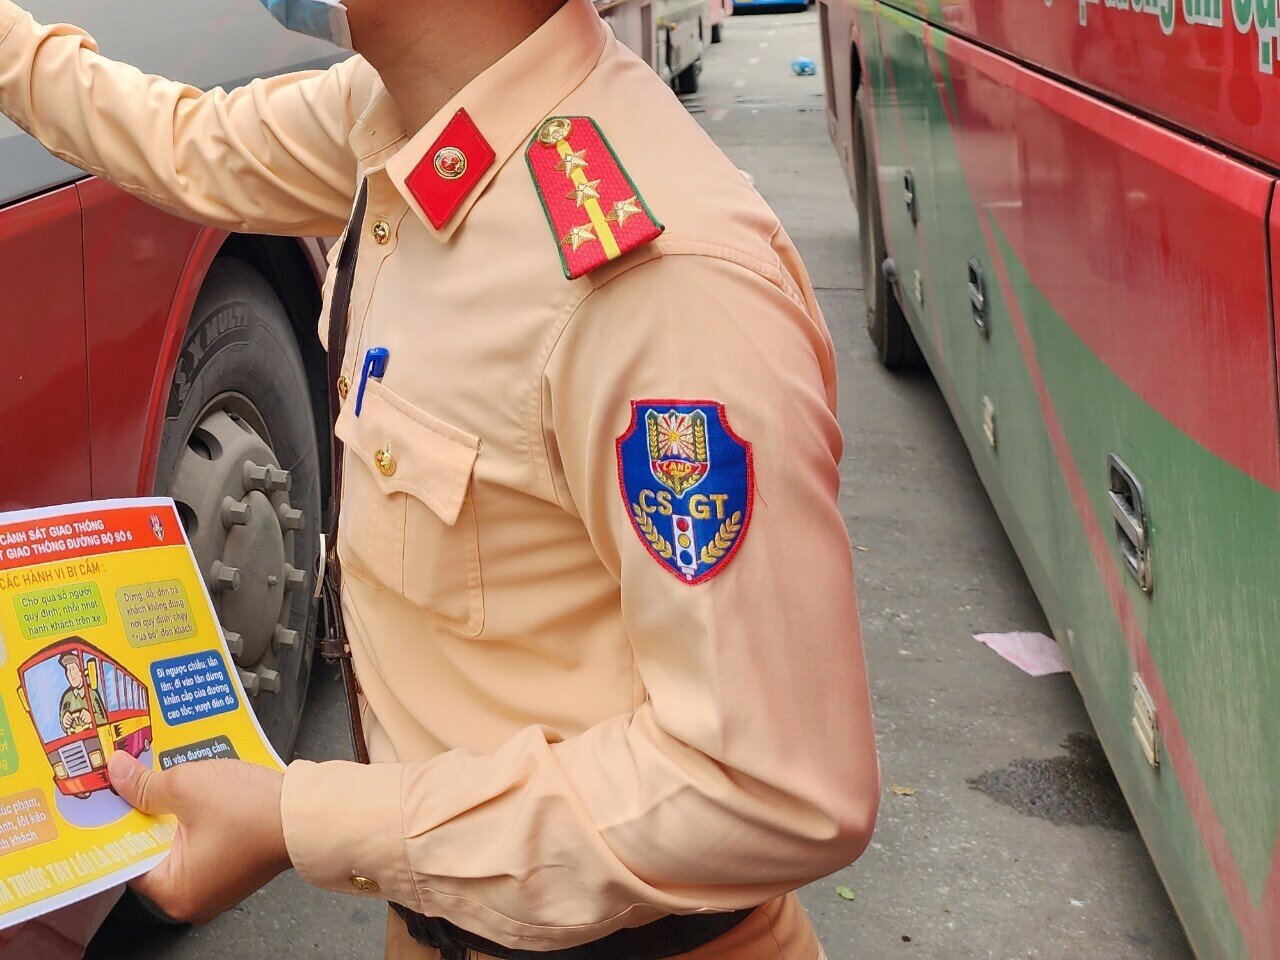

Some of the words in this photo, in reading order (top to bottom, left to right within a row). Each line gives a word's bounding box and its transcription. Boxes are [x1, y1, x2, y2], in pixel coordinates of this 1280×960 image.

[639, 489, 672, 515] CS
[689, 494, 729, 519] GT
[0, 531, 27, 545] CẢNH
[28, 526, 47, 540] SÁT
[49, 524, 72, 537] GIAO
[74, 519, 104, 533] THÔNG
[6, 546, 30, 560] GIAO
[31, 538, 66, 555] THÔNG
[67, 534, 101, 550] ĐƯỜNG
[101, 533, 114, 545] BỘ
[115, 530, 127, 542] SỐ
[127, 530, 133, 541] 6
[0, 574, 20, 590] CÁC
[24, 569, 53, 584] HÀNH
[55, 567, 65, 579] VI
[67, 564, 78, 581] BỊ
[80, 557, 100, 575] CẤM
[41, 593, 56, 605] quá
[126, 605, 146, 616] khách
[147, 600, 168, 613] không
[24, 613, 39, 623] quy
[28, 626, 48, 636] hành
[50, 620, 74, 632] khách
[75, 617, 91, 626] trên
[92, 614, 101, 622] xe
[130, 618, 142, 628] nơi
[143, 618, 156, 628] quy
[157, 668, 165, 678] Đi
[166, 665, 187, 677] ngược
[175, 678, 181, 689] đi
[182, 676, 194, 686] vào
[195, 674, 205, 684] làn
[206, 670, 224, 681] dừng
[163, 692, 180, 706] khẩn
[181, 689, 194, 702] cấp
[194, 687, 206, 698] của
[207, 683, 230, 696] đường
[167, 710, 180, 719] cao
[195, 701, 210, 712] vượt
[211, 697, 225, 708] đèn
[225, 694, 234, 705] đỏ
[163, 756, 172, 768] Đi
[173, 753, 186, 764] vào
[187, 746, 212, 760] đường
[17, 816, 29, 827] lôi
[30, 812, 46, 823] kéo
[10, 830, 38, 847] khách
[45, 858, 76, 885] TAY
